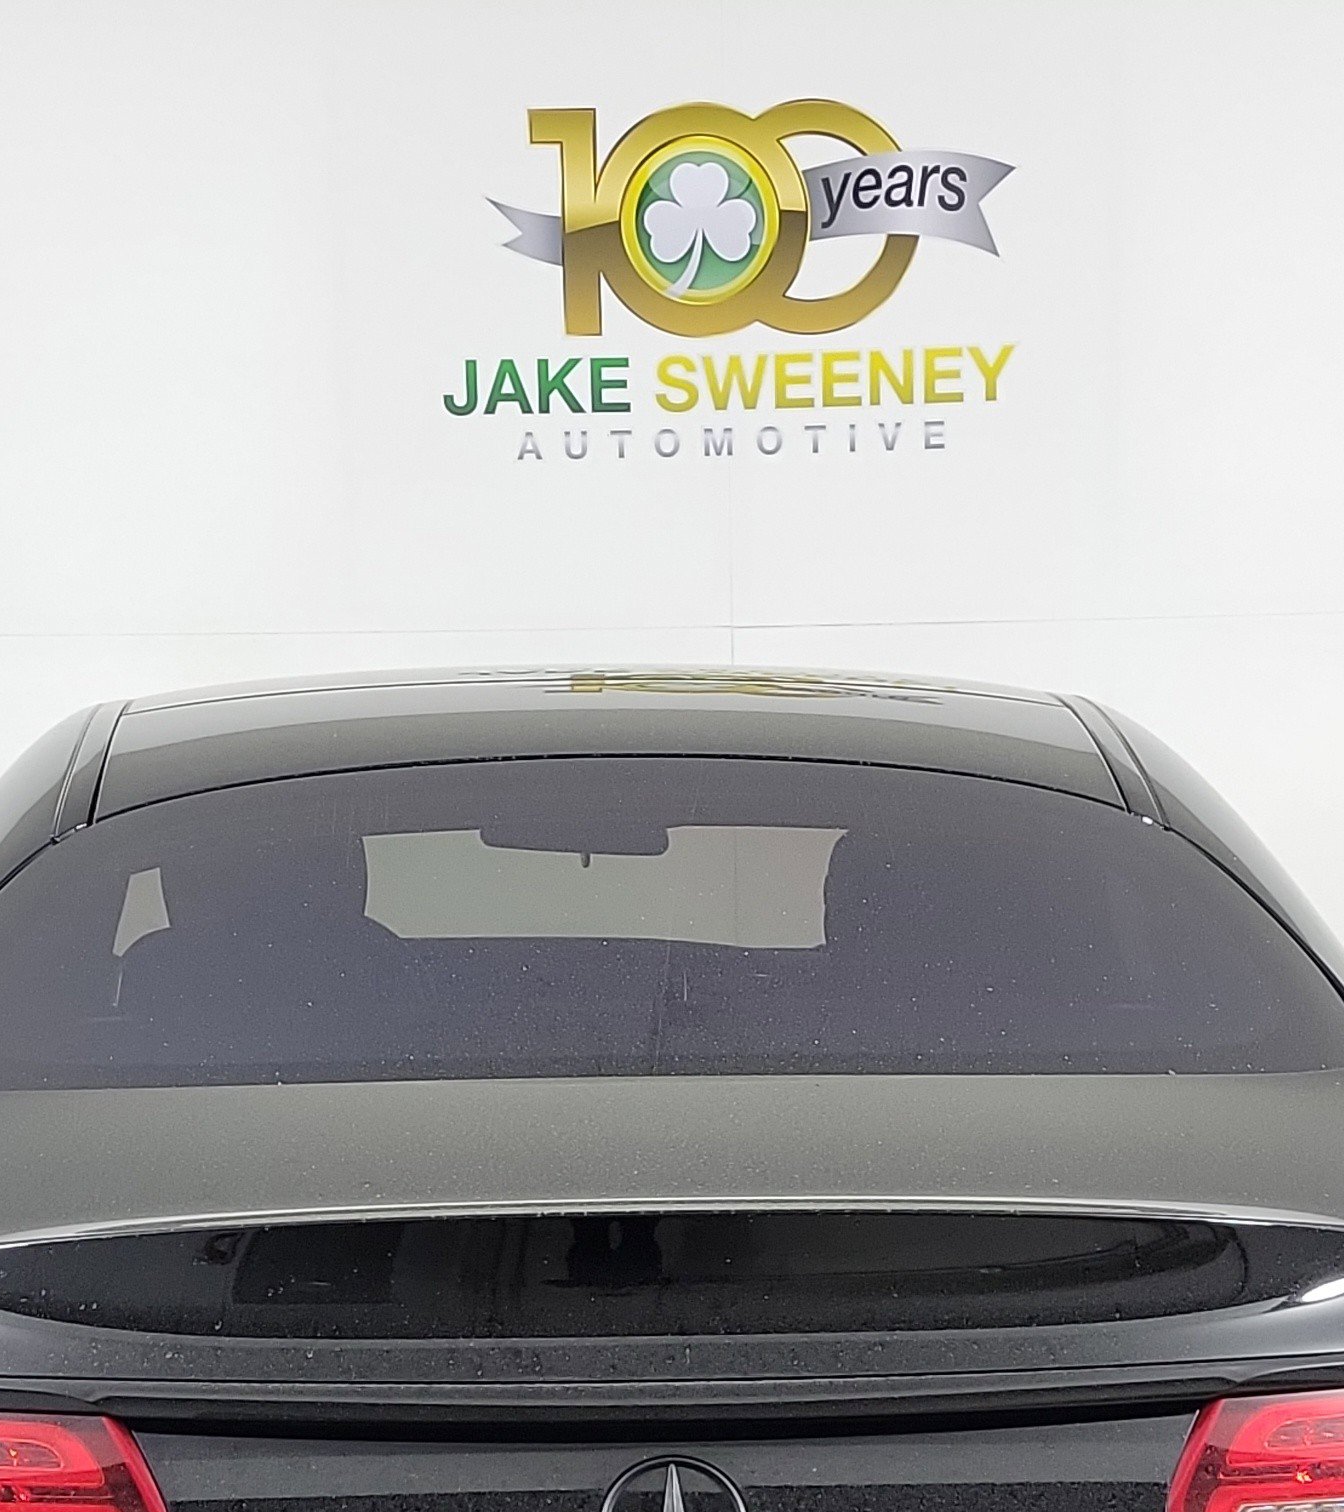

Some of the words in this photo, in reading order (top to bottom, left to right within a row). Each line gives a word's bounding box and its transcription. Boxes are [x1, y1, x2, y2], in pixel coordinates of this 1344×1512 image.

[527, 98, 919, 337] 100
[818, 163, 969, 228] years
[443, 357, 632, 416] JAKE
[656, 345, 1015, 412] SWEENEY
[517, 421, 946, 461] AUTOMOTIVE
